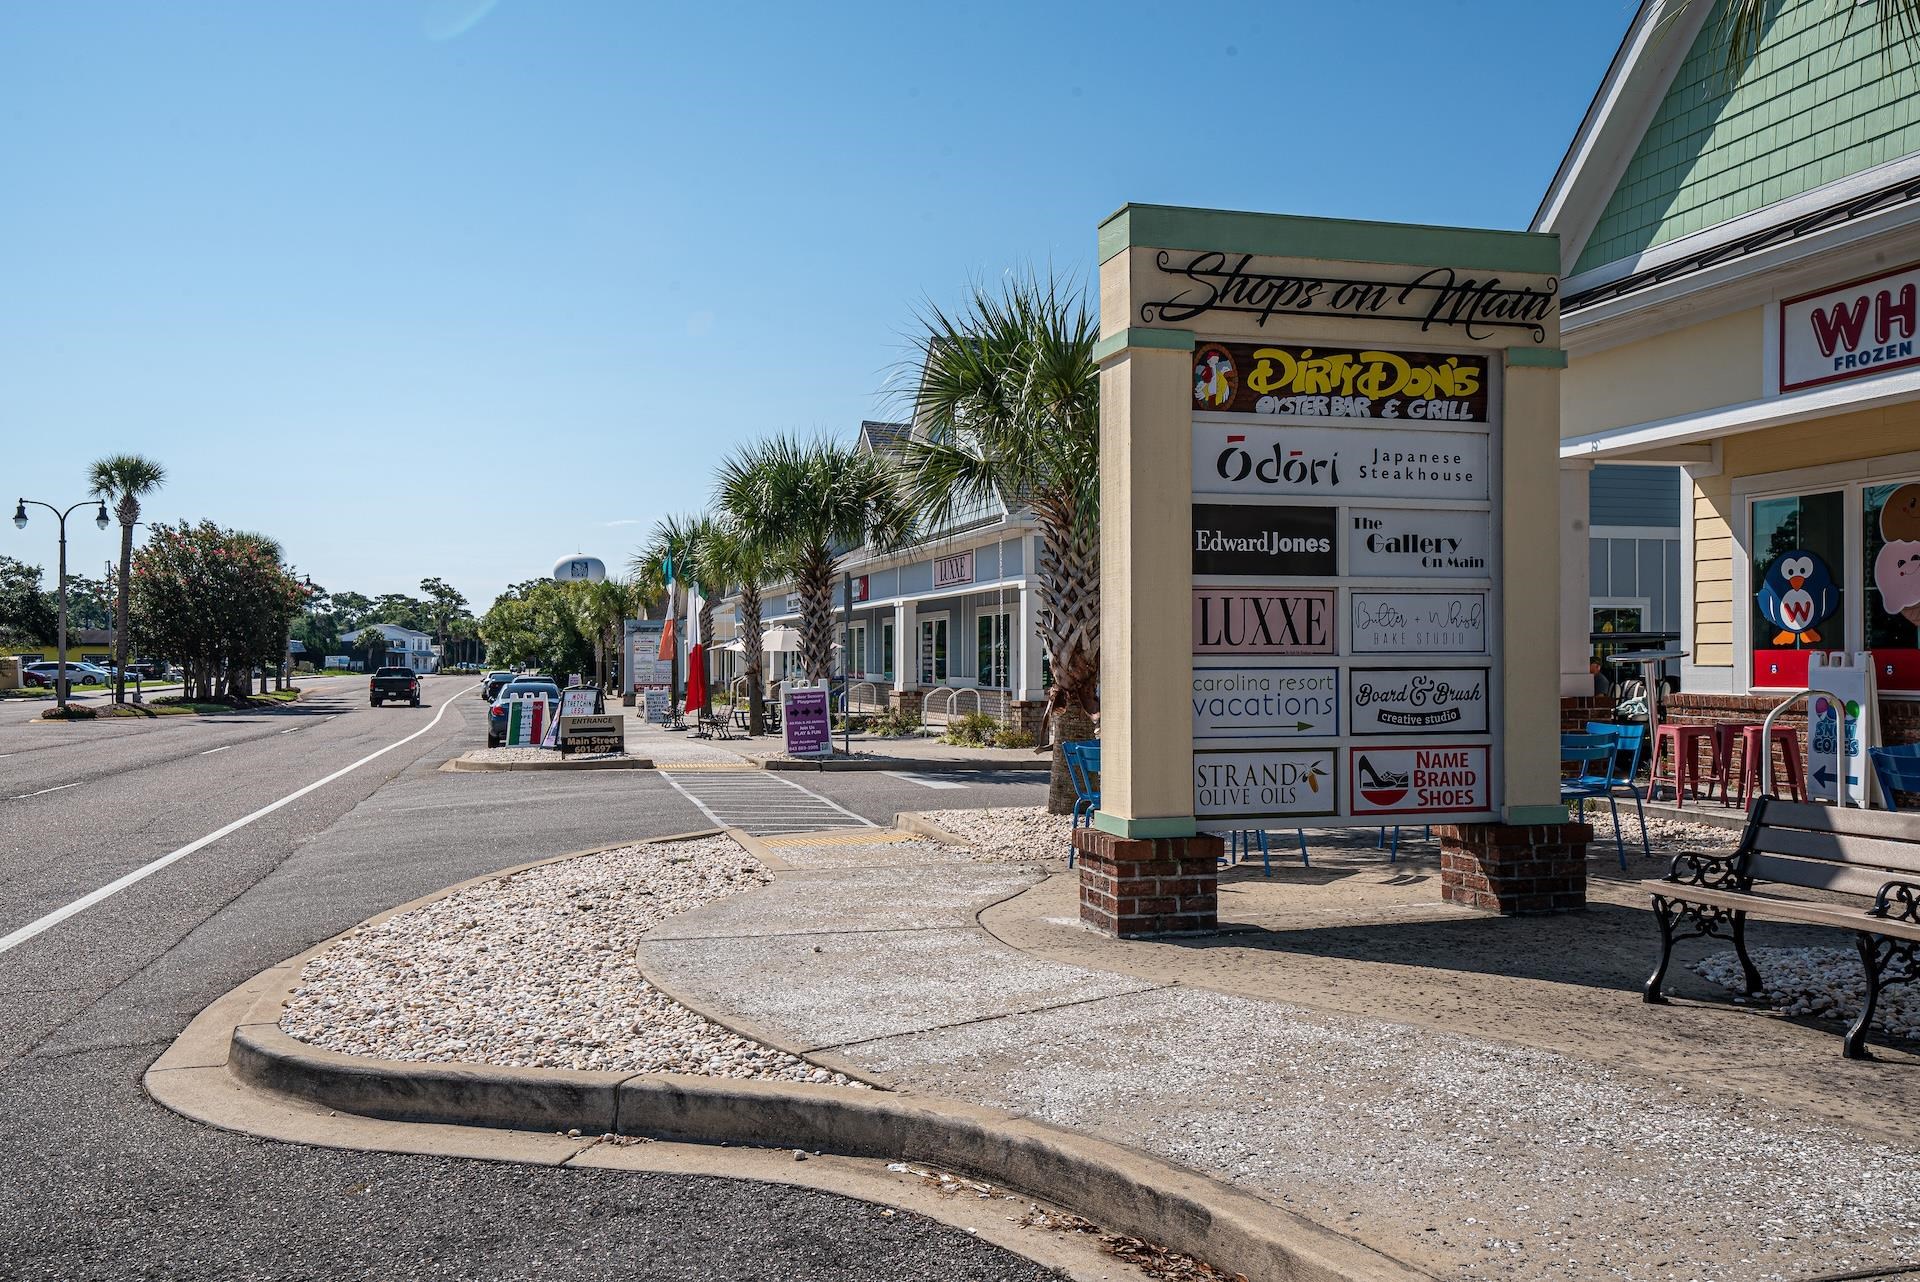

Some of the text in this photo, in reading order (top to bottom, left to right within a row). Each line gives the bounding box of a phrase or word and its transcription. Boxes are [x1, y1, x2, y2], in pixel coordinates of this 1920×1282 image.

[1158, 251, 1557, 340] Shops on Main
[1834, 340, 1912, 371] FROZEN
[1255, 395, 1474, 421] OYSTER BAR & GRILL
[1372, 448, 1462, 466] Japanese
[1359, 465, 1474, 482] Steakhouse
[1352, 517, 1383, 529] The
[1195, 529, 1331, 555] Edward Jones
[1366, 533, 1463, 554] Gallery
[939, 556, 966, 582] LUXXE
[1421, 556, 1485, 568] On Main
[1354, 600, 1408, 630] Butter
[1428, 600, 1481, 630] Whisk
[1783, 600, 1811, 623] W
[1198, 597, 1328, 646] LUXXE
[1373, 632, 1464, 645] BAKE STUDIO
[1192, 673, 1334, 691] carolina resort
[1355, 675, 1482, 706] Board & Brush
[572, 693, 587, 701] MORE
[1192, 693, 1333, 717] vacations
[1381, 710, 1457, 724] creative studio
[1815, 719, 1857, 738] SNW
[567, 736, 619, 746] Main Street
[574, 745, 611, 754] 601-697
[1416, 751, 1469, 769] NAME
[1197, 763, 1298, 788] STRAND
[1413, 770, 1477, 788] BRAND
[1199, 787, 1296, 806] OLIVE OILS
[1417, 788, 1474, 806] SHOES
